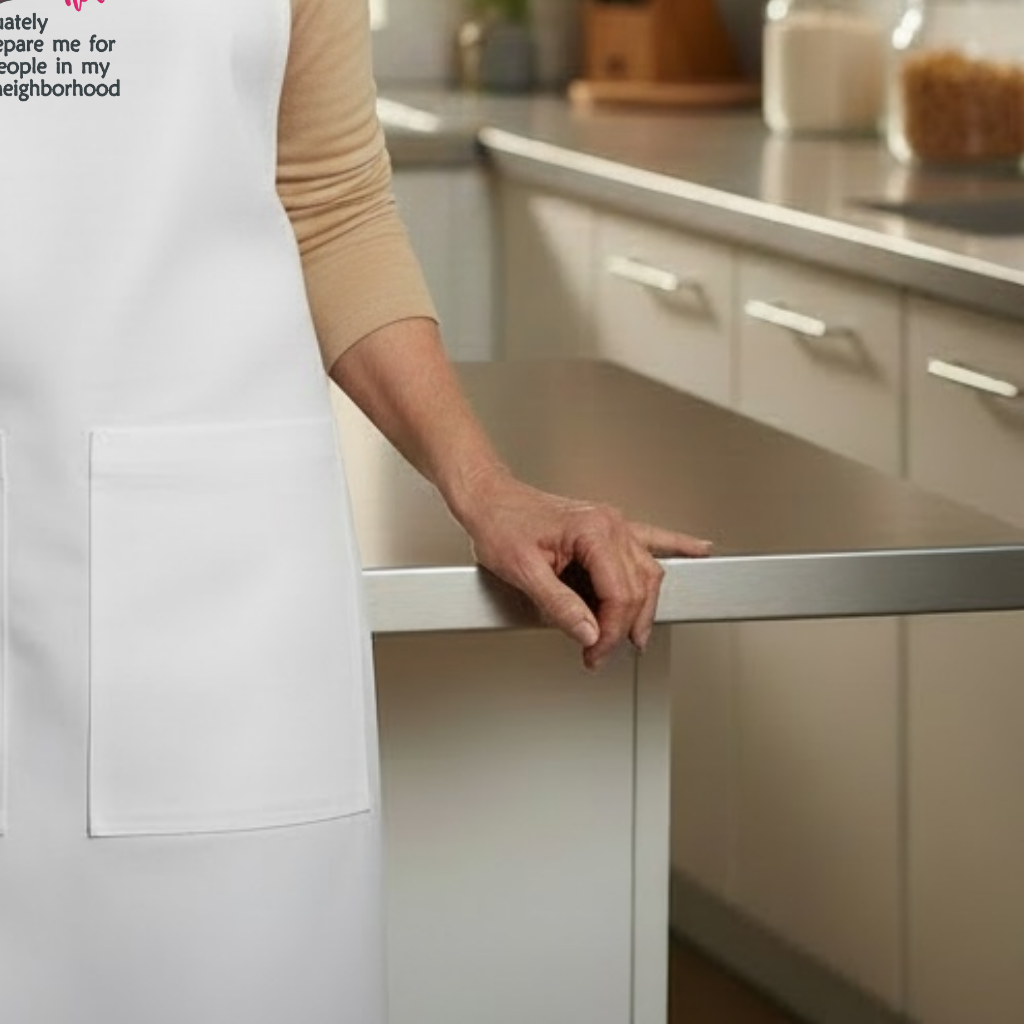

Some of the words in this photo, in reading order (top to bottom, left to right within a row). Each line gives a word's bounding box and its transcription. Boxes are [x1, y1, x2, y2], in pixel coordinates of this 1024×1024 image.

[52, 39, 81, 53] me
[89, 34, 116, 53] for
[56, 57, 73, 75] in
[81, 62, 111, 79] my
